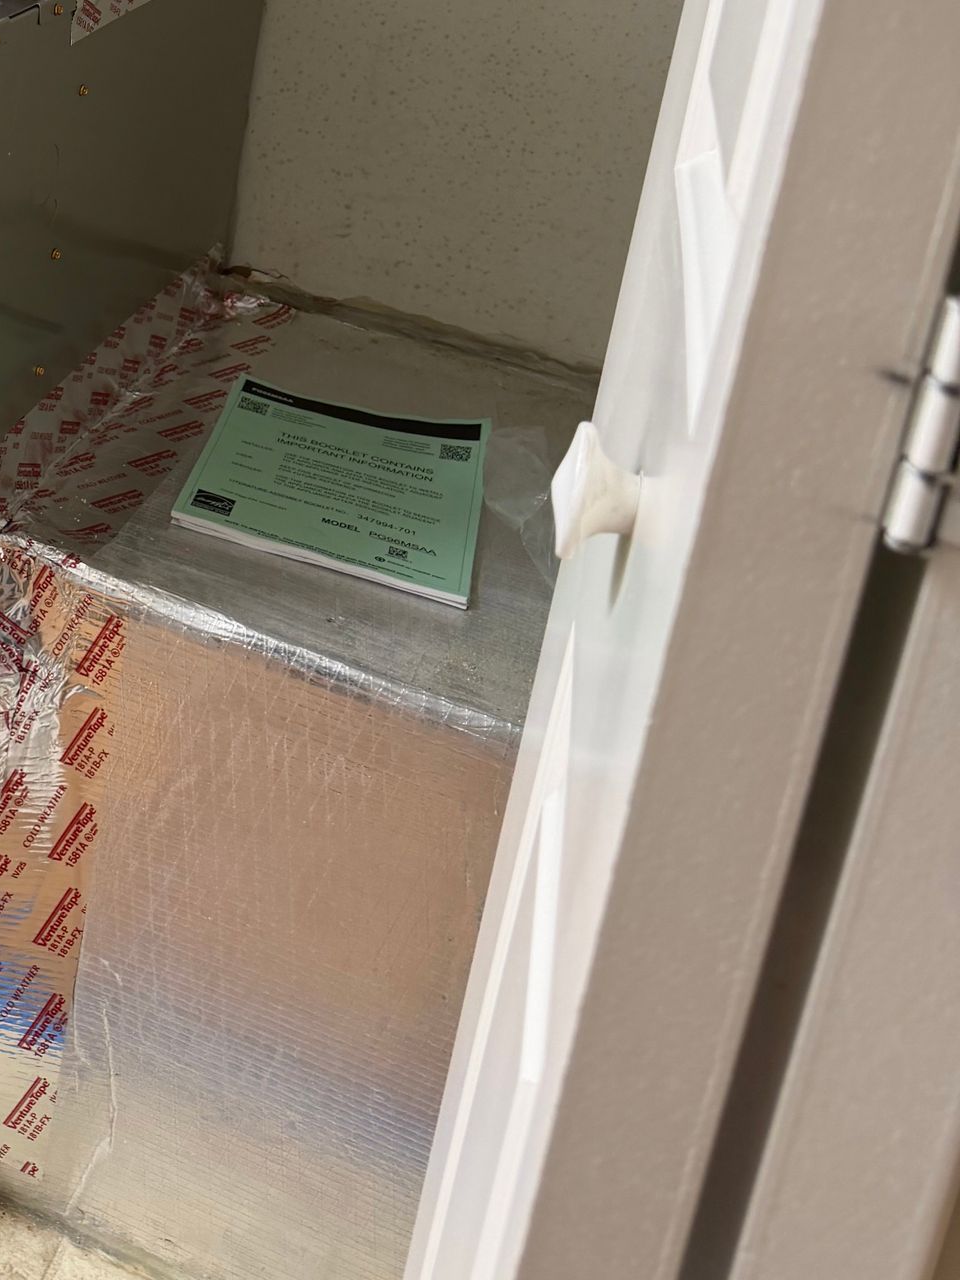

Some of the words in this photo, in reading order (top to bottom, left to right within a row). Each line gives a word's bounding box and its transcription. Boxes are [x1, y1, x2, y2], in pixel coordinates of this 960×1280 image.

[277, 438, 344, 460] IMPORTANT
[349, 456, 433, 482] INFORMATION
[280, 431, 308, 443] THIS
[310, 438, 368, 458] BOOKLET
[371, 455, 434, 475] CONTAINS
[321, 517, 361, 533] MODEL
[26, 610, 48, 636] 1581A
[52, 632, 69, 657] COLD
[67, 594, 94, 634] WEATHER
[79, 616, 125, 678] VentureTape
[91, 656, 116, 686] 1581A
[64, 709, 108, 767] VentureTape
[75, 747, 95, 773] 181A-P
[84, 750, 110, 780] 181B-FX
[22, 826, 40, 848] COLD
[39, 784, 68, 825] WEATHER
[52, 804, 97, 862] VentureTape
[11, 861, 27, 879] IV/25
[65, 841, 88, 869] 1581A
[39, 888, 82, 947] VentureTape
[48, 926, 68, 953] 181A-P
[58, 927, 84, 959] 181B-FX
[13, 964, 40, 1001] WEATHER
[21, 994, 66, 1051] VentureTape
[34, 1033, 58, 1058] 1581A
[7, 1078, 50, 1130] VentureTape
[18, 1113, 38, 1136] 181A-P
[27, 1114, 52, 1142] 181B-FX
